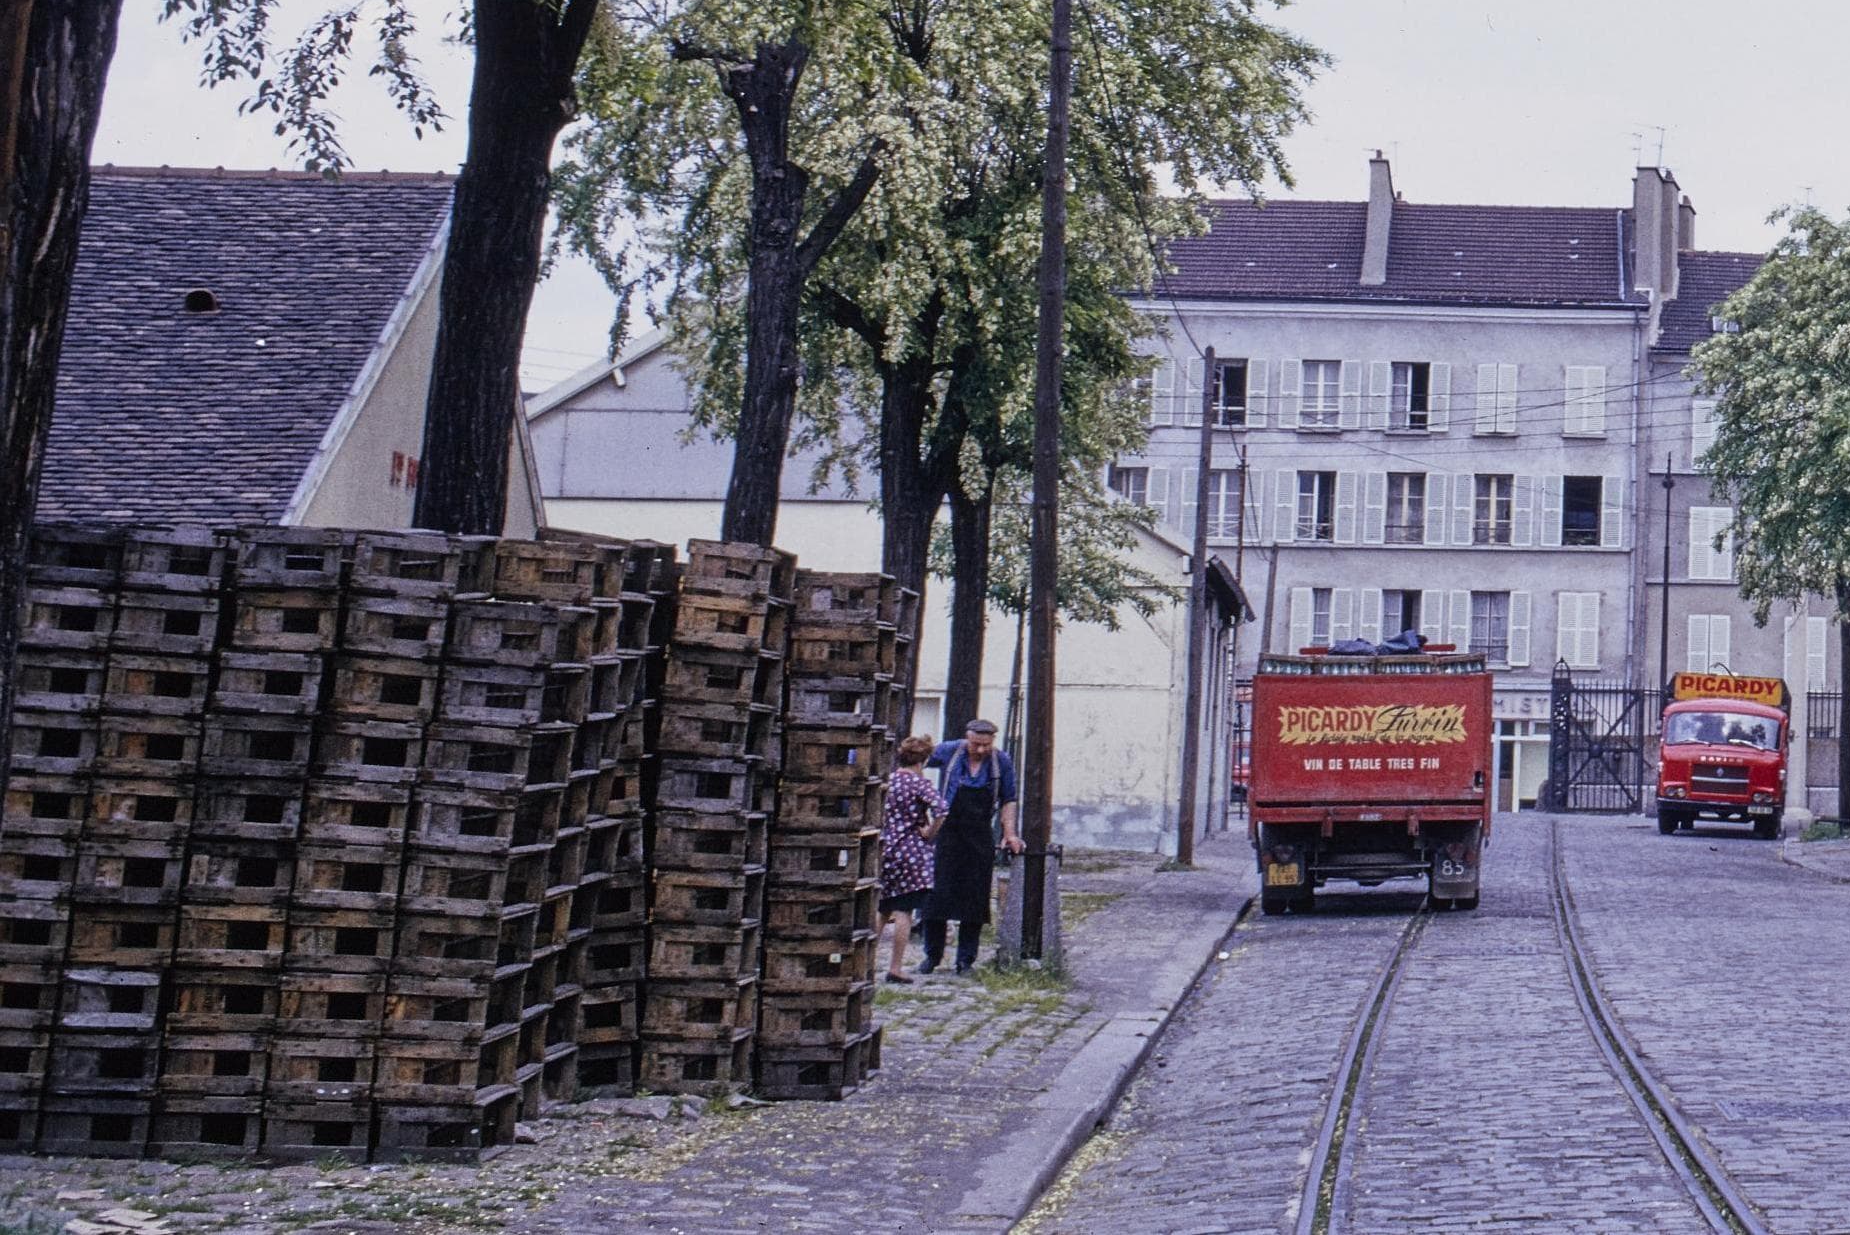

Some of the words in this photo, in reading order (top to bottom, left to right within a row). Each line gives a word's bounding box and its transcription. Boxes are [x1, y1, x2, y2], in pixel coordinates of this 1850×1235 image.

[1680, 675, 1779, 696] PICARDY
[1286, 710, 1378, 733] PICARDY
[1303, 758, 1324, 771] VIN
[1328, 759, 1343, 771] DE
[1348, 758, 1381, 770] TABLE
[1386, 757, 1415, 770] TRES
[1420, 757, 1440, 770] FIN
[1441, 859, 1465, 876] 85
